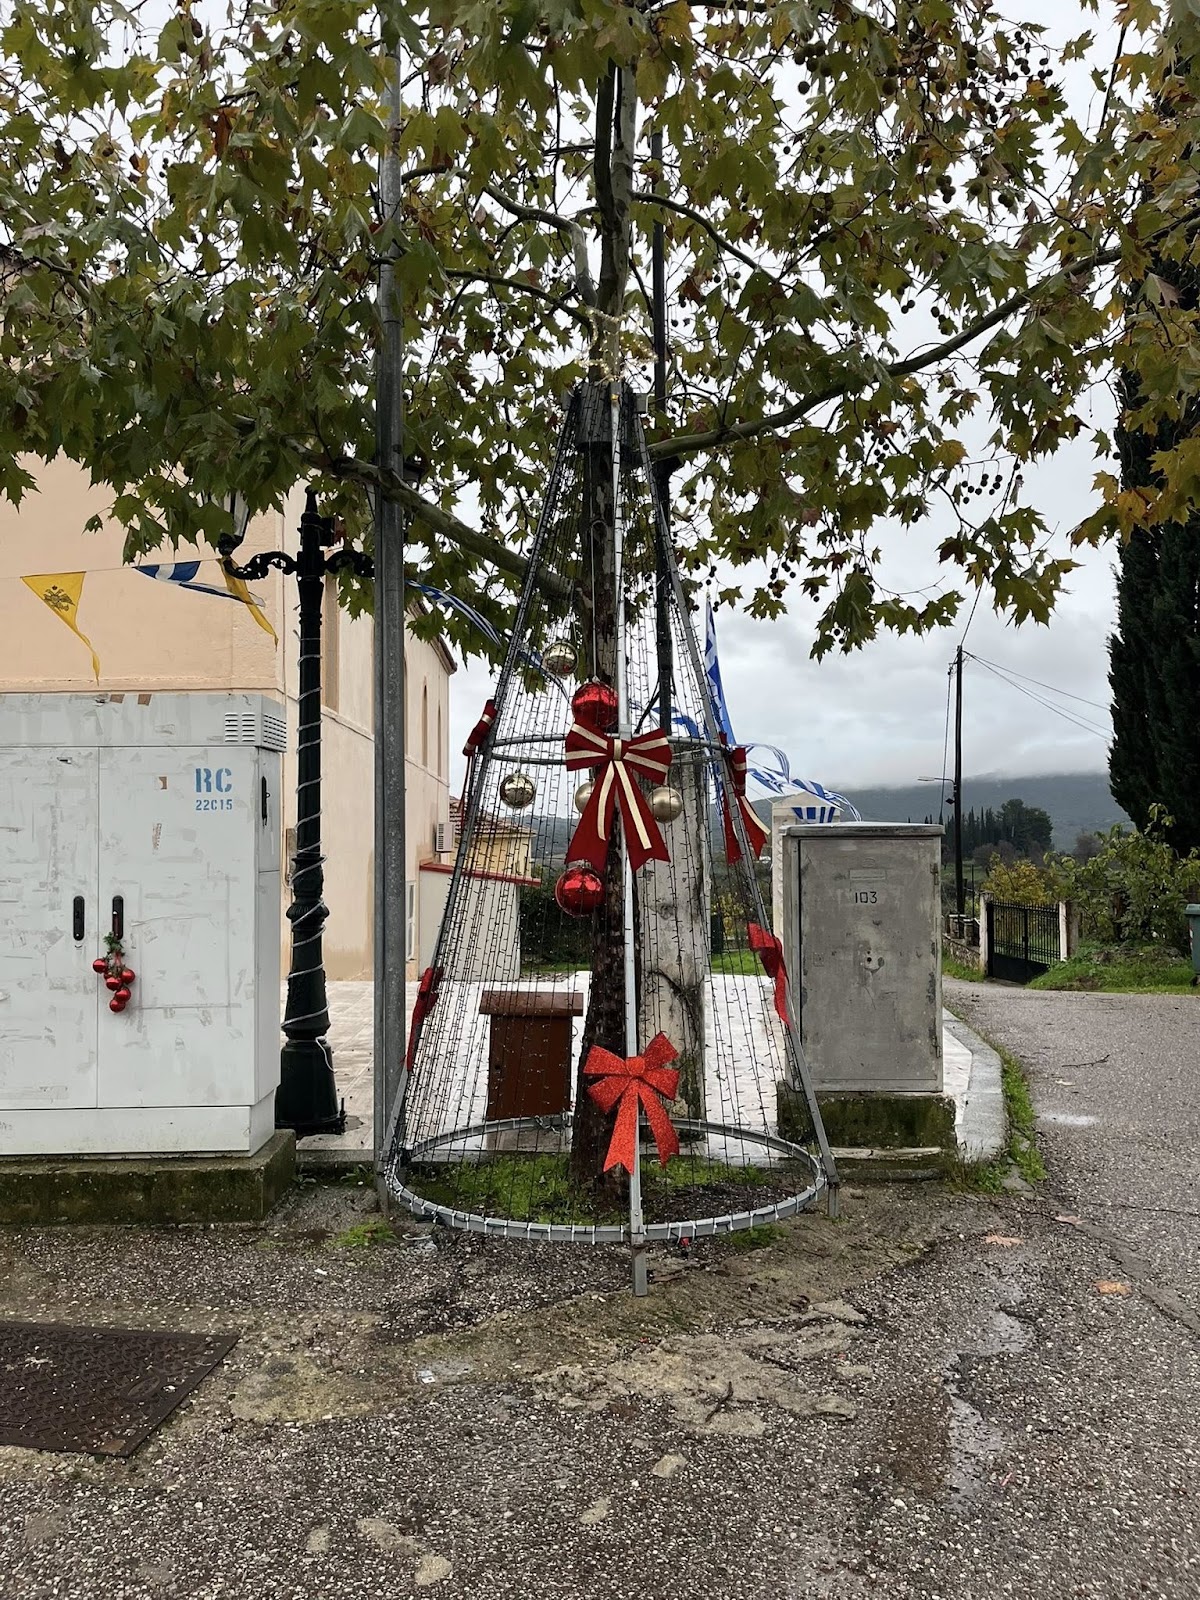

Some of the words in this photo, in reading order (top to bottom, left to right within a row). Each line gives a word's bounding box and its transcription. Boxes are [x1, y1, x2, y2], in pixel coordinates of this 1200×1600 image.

[195, 768, 232, 792] RC
[195, 799, 233, 811] 22C15
[855, 891, 878, 904] 103
